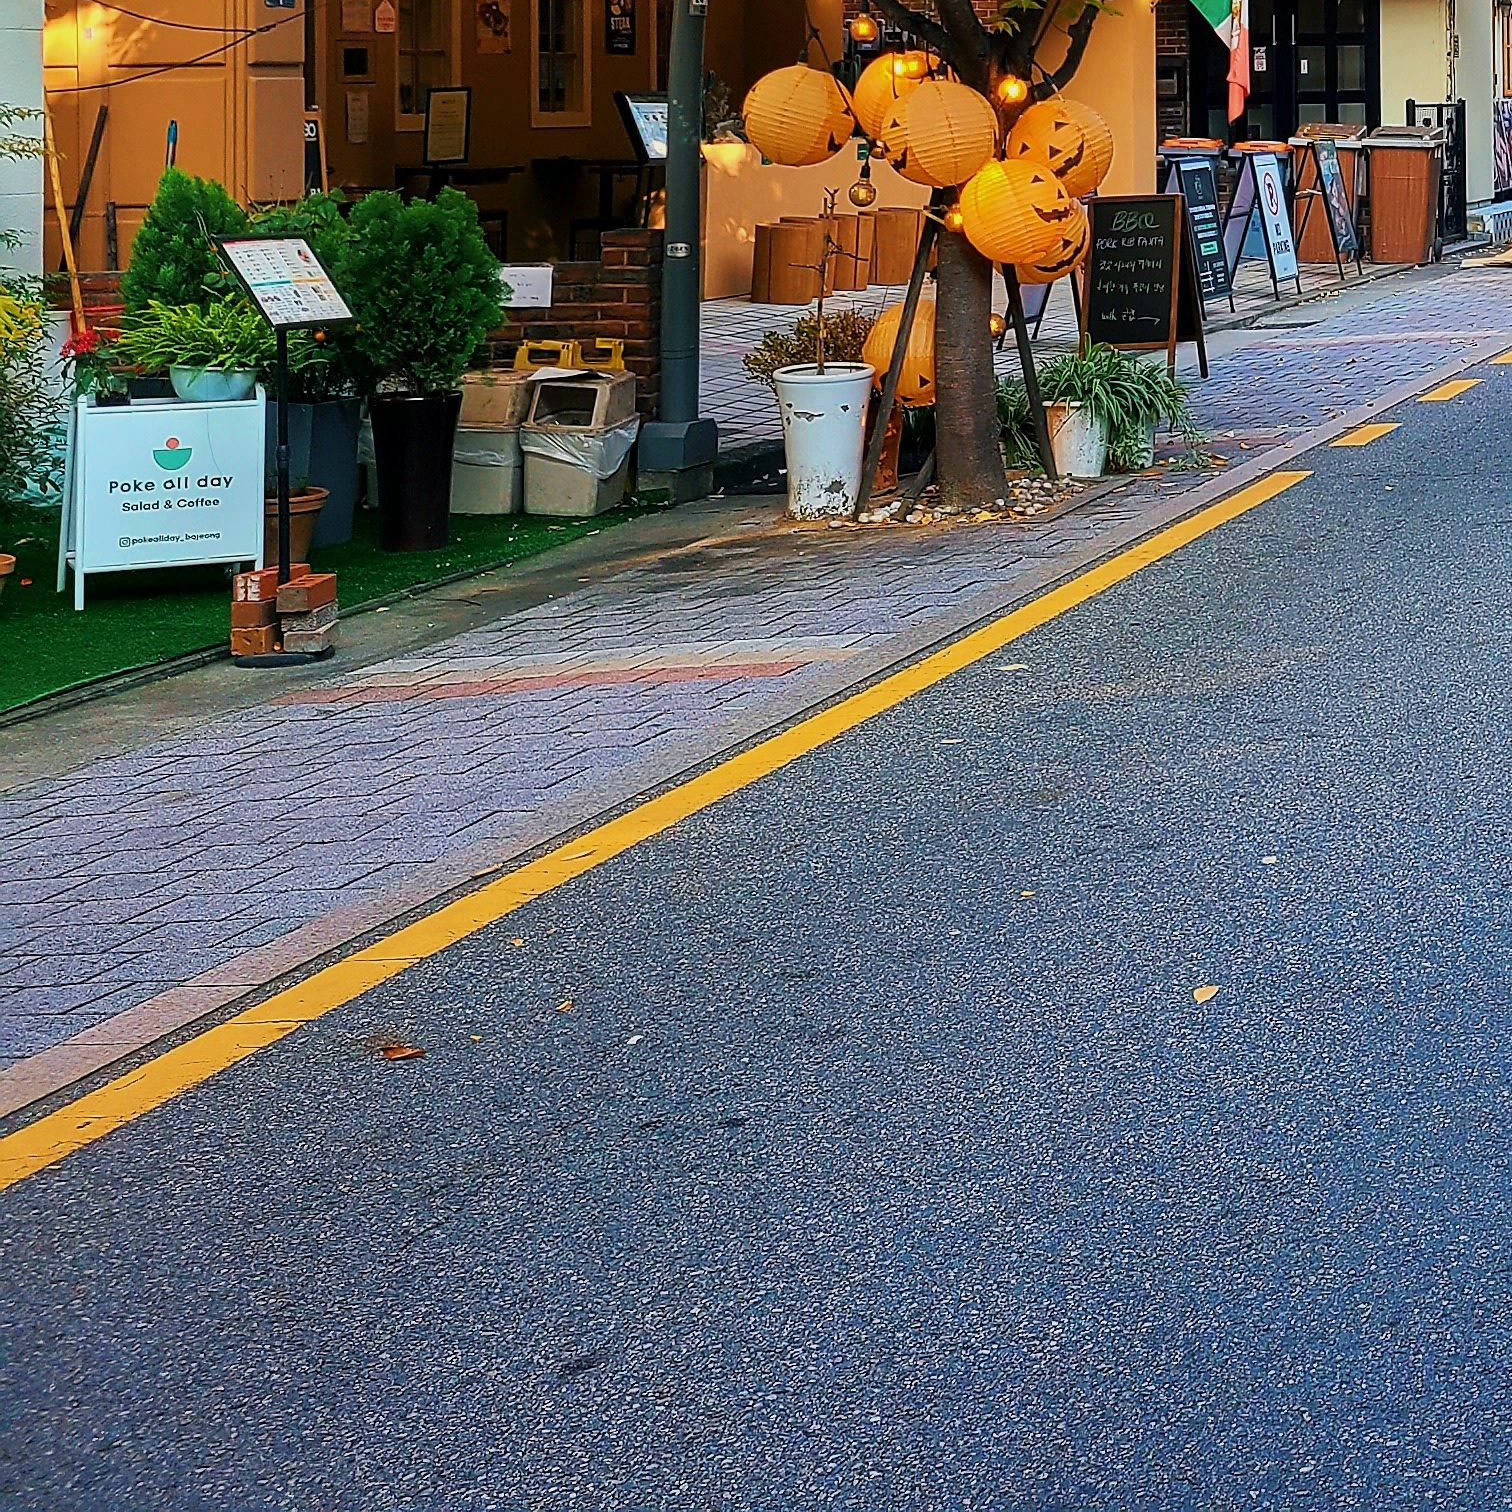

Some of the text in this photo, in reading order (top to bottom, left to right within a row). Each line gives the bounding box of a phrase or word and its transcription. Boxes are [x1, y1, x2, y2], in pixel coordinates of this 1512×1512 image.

[1110, 210, 1160, 233] BBQ
[1096, 237, 1118, 249] PORK
[109, 475, 234, 494] Poke all day
[121, 497, 220, 512] Salad & Coffee
